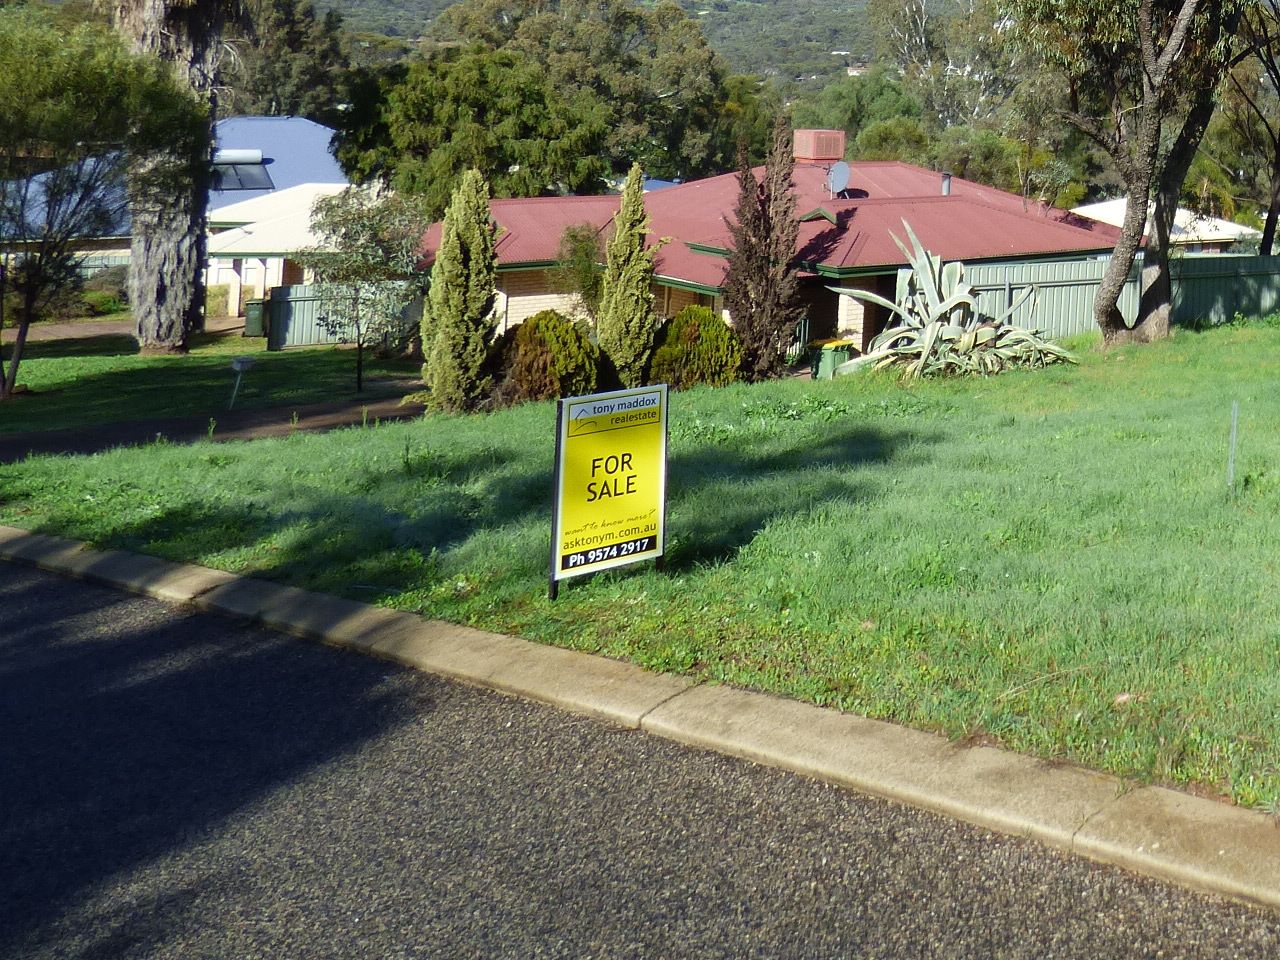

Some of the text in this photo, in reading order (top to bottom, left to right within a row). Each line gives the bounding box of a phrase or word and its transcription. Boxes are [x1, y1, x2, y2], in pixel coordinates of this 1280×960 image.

[593, 397, 657, 415] tony maddox
[610, 410, 657, 425] realestate
[591, 452, 633, 478] FOR
[586, 474, 638, 503] SALE
[563, 523, 657, 550] asktonym.com.au
[569, 538, 649, 567] Ph 9574 2917
